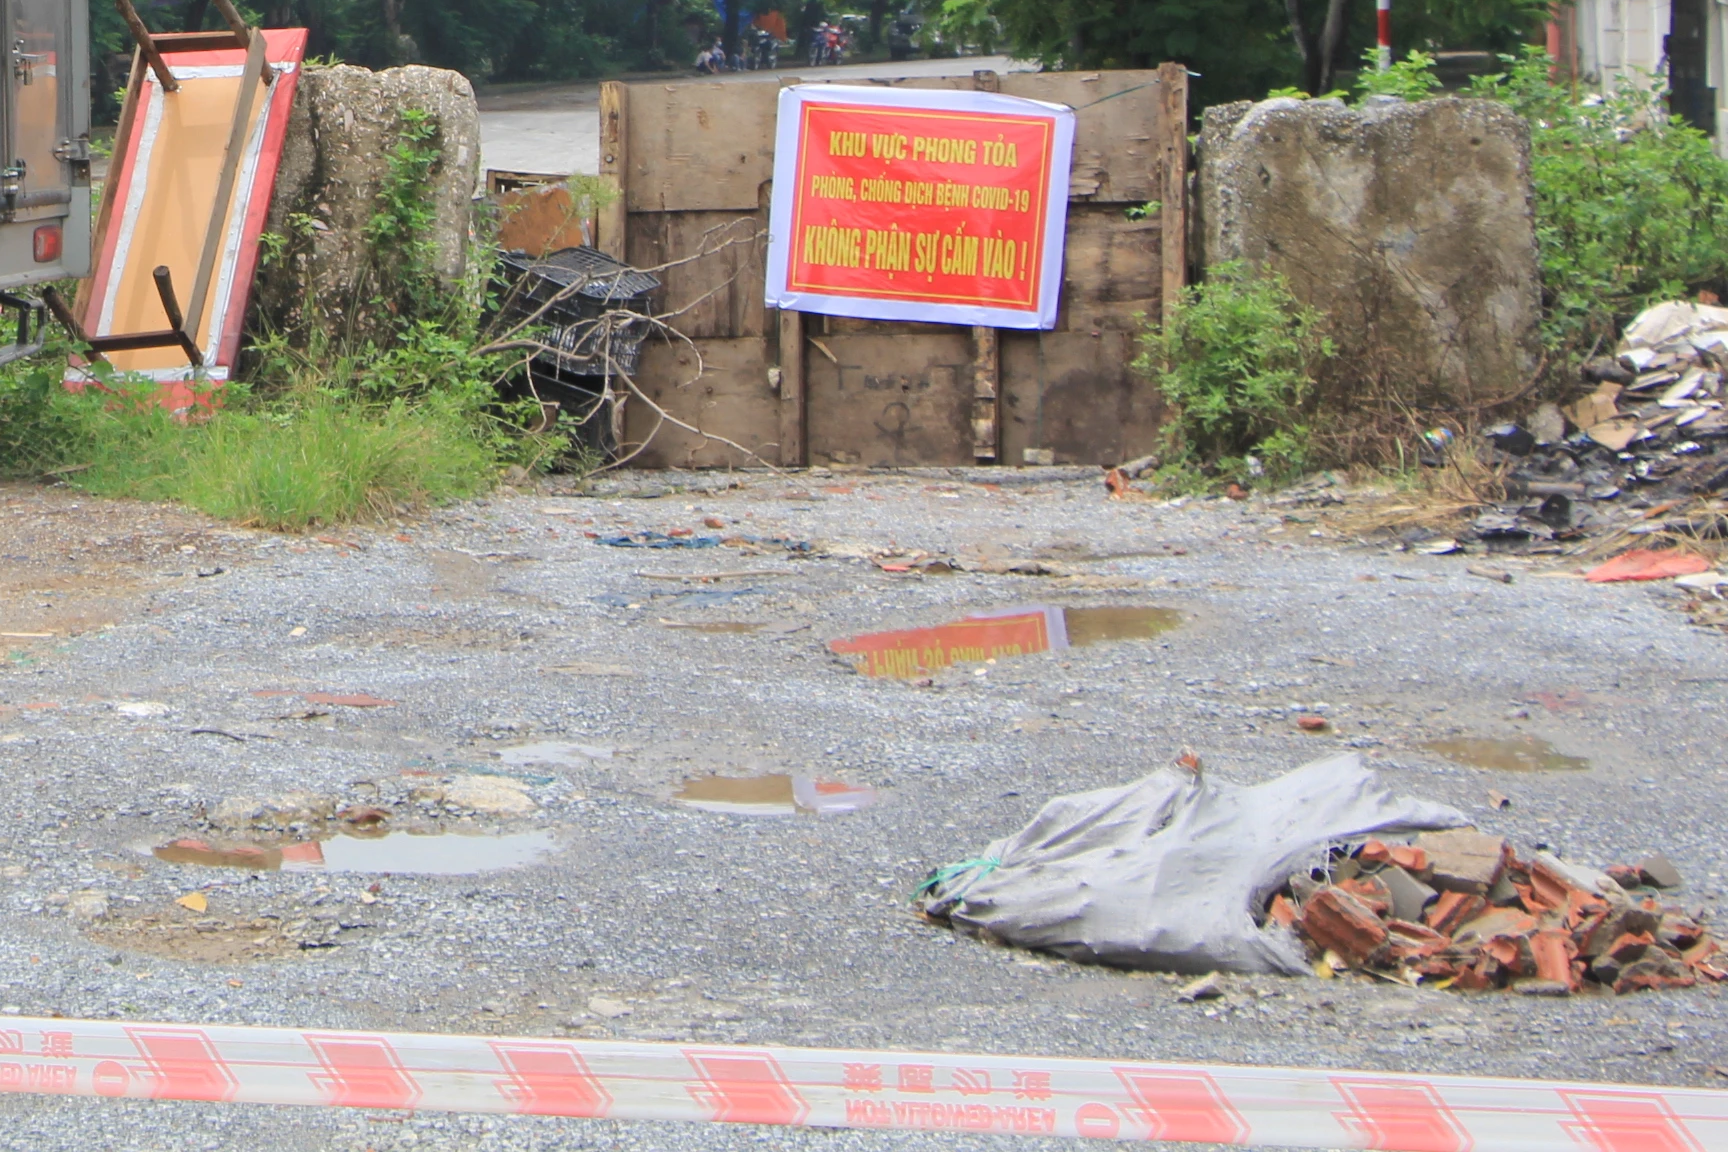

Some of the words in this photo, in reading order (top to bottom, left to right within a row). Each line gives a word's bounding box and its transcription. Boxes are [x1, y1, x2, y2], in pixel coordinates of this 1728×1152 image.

[829, 131, 867, 158] KHU
[872, 132, 908, 165] VỰC
[912, 138, 977, 165] PHONG
[983, 134, 1018, 168] TỎA
[811, 170, 857, 204] PHÒNG,
[860, 171, 902, 204] CHỐNG
[904, 181, 933, 210] DỊCH
[935, 179, 969, 212] BỆNH
[971, 185, 1031, 214] COVID-19
[803, 219, 862, 268] KHÔNG
[864, 223, 912, 280] PHẬN
[914, 229, 941, 282] SỰ
[941, 221, 980, 277] CẤM
[982, 230, 1016, 281] VÀO
[1019, 241, 1029, 281] !
